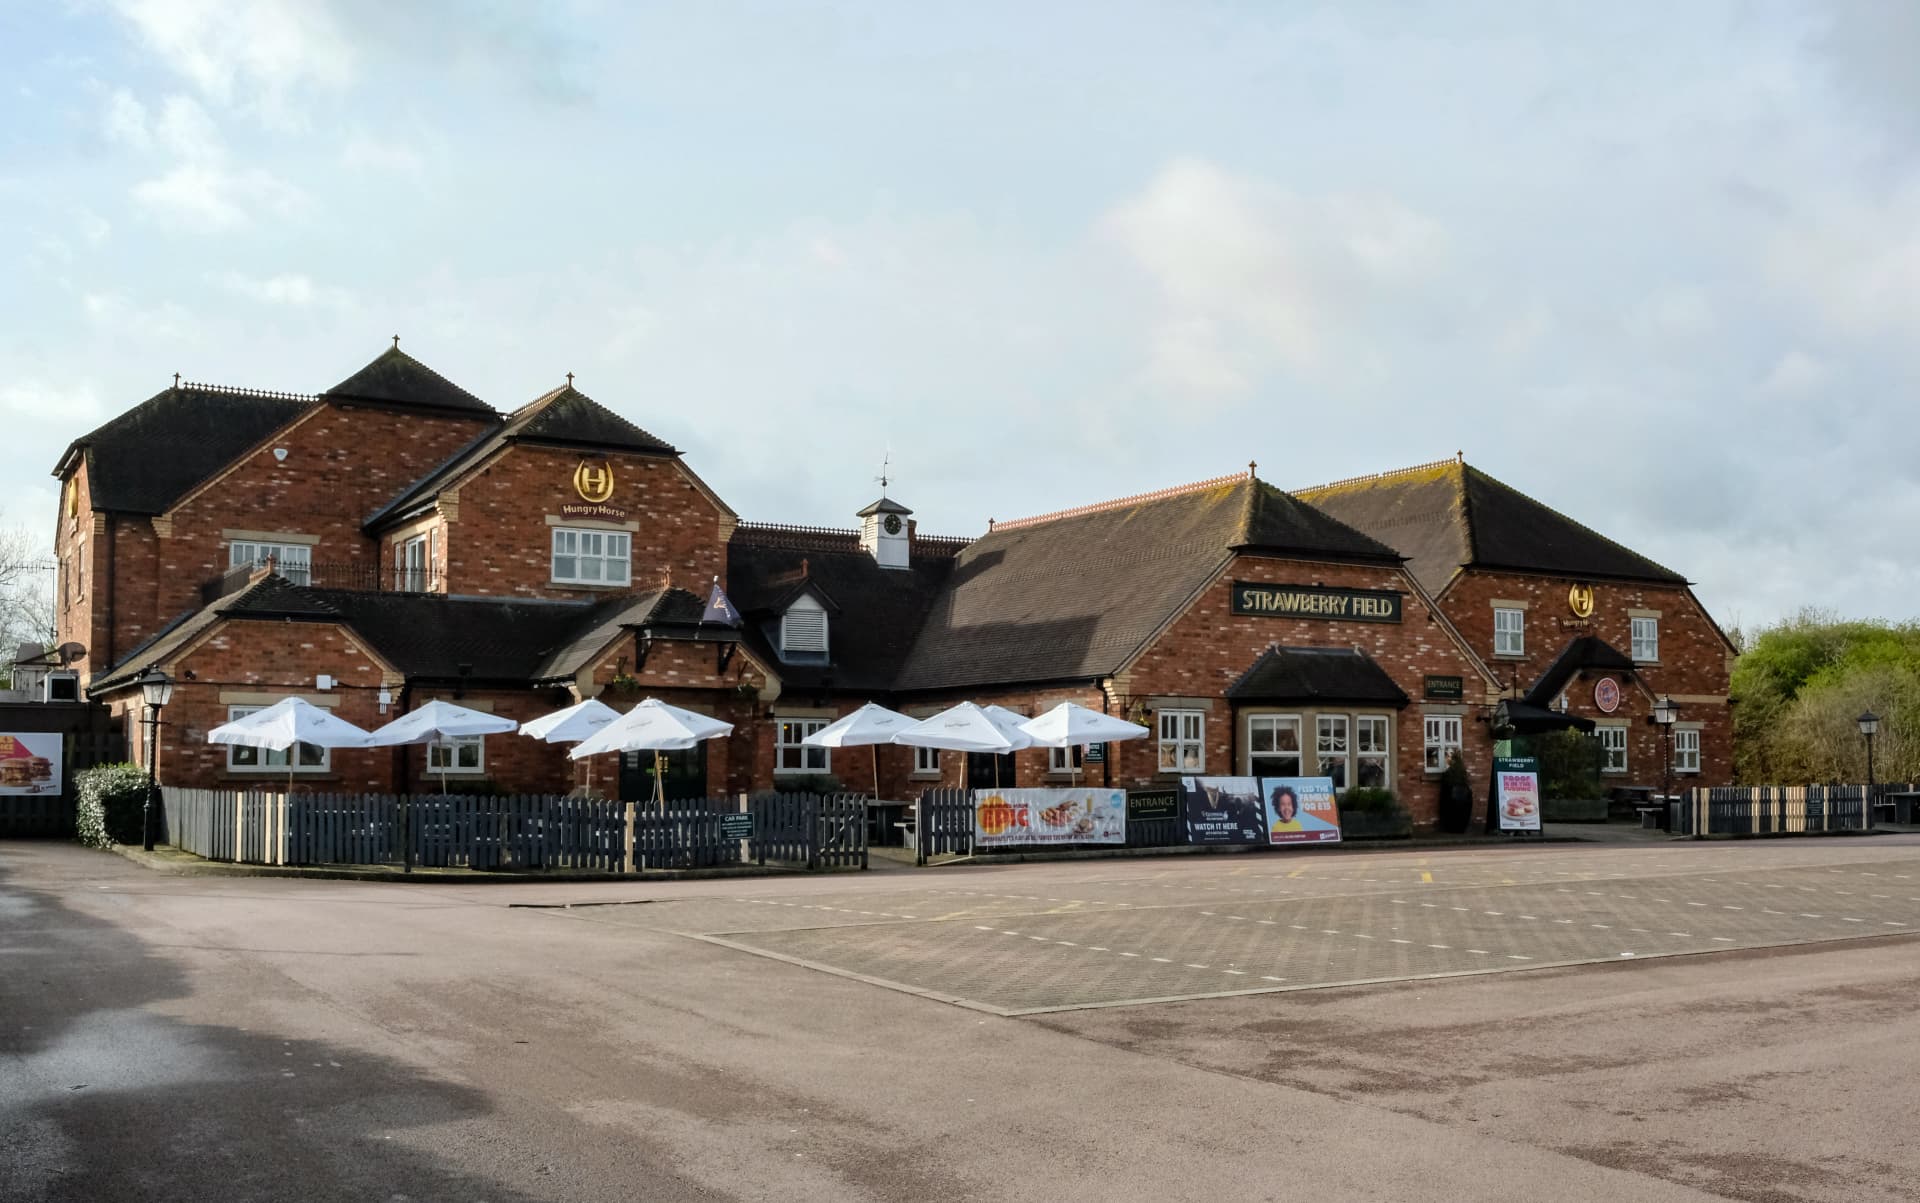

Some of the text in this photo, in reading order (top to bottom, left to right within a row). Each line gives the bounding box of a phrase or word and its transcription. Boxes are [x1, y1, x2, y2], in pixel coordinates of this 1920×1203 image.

[563, 504, 625, 517] Hungry Horse
[1242, 590, 1393, 617] STRAWBERRY FIELD
[1427, 680, 1460, 689] ENTRANCE
[1130, 796, 1175, 808] ENTRANCE
[983, 808, 1029, 828] EPIC
[1194, 823, 1215, 831] WATCH
[1222, 822, 1238, 830] HERE
